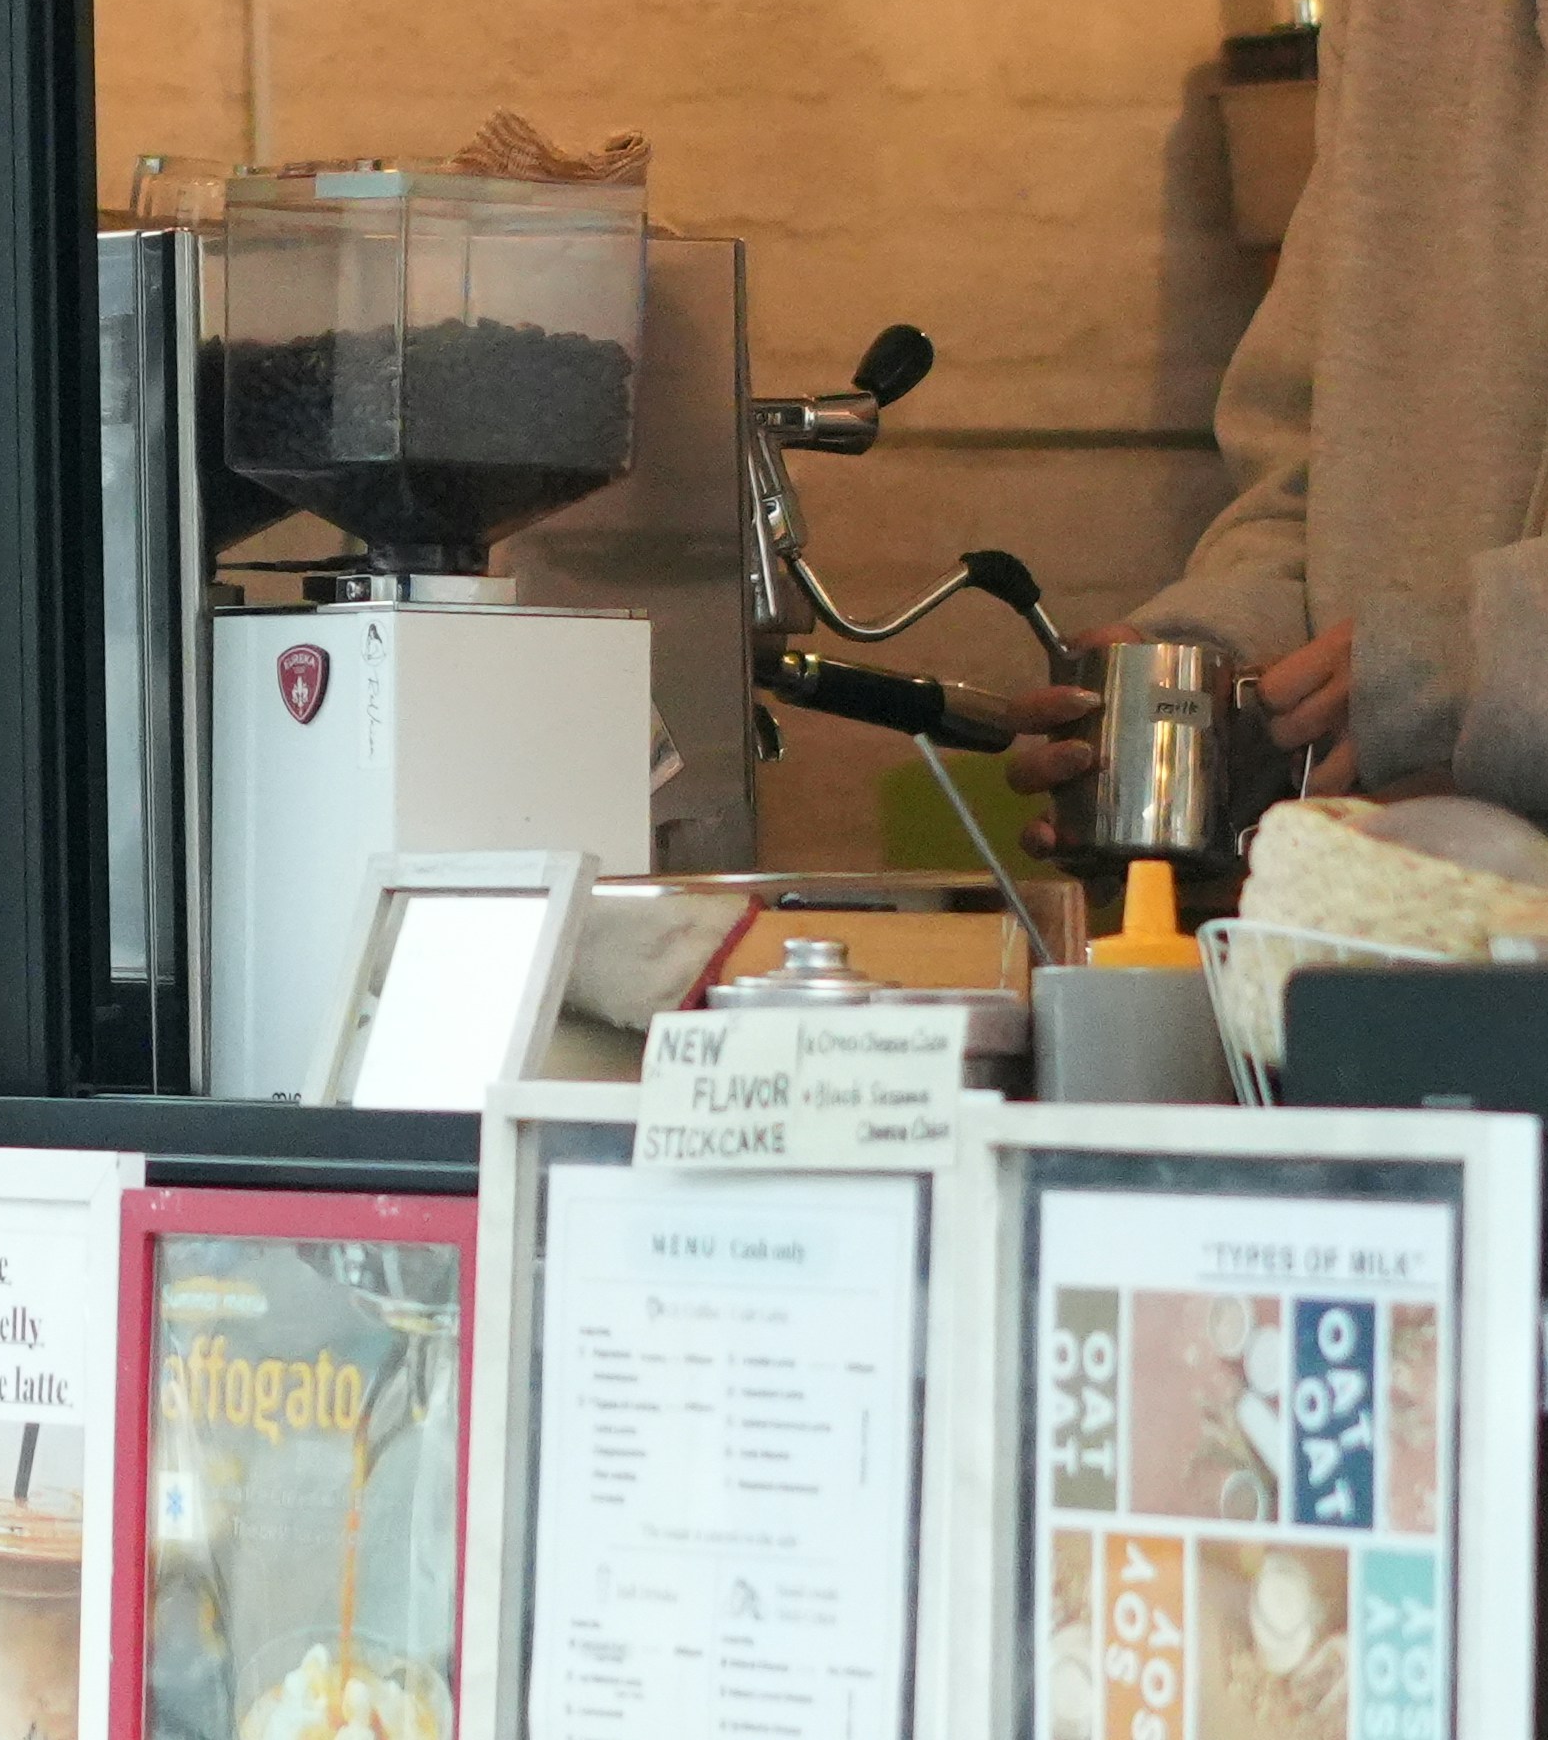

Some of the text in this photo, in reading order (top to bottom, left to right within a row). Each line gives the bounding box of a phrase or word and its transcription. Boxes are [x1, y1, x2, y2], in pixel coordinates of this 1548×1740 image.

[658, 1026, 727, 1067] NEW
[692, 1071, 790, 1115] FLAVOR
[14, 1365, 70, 1405] latte
[161, 1334, 362, 1447] affogato
[1081, 1330, 1116, 1477] OAT
[1317, 1308, 1373, 1452] OAT
[1294, 1376, 1354, 1520] OAT
